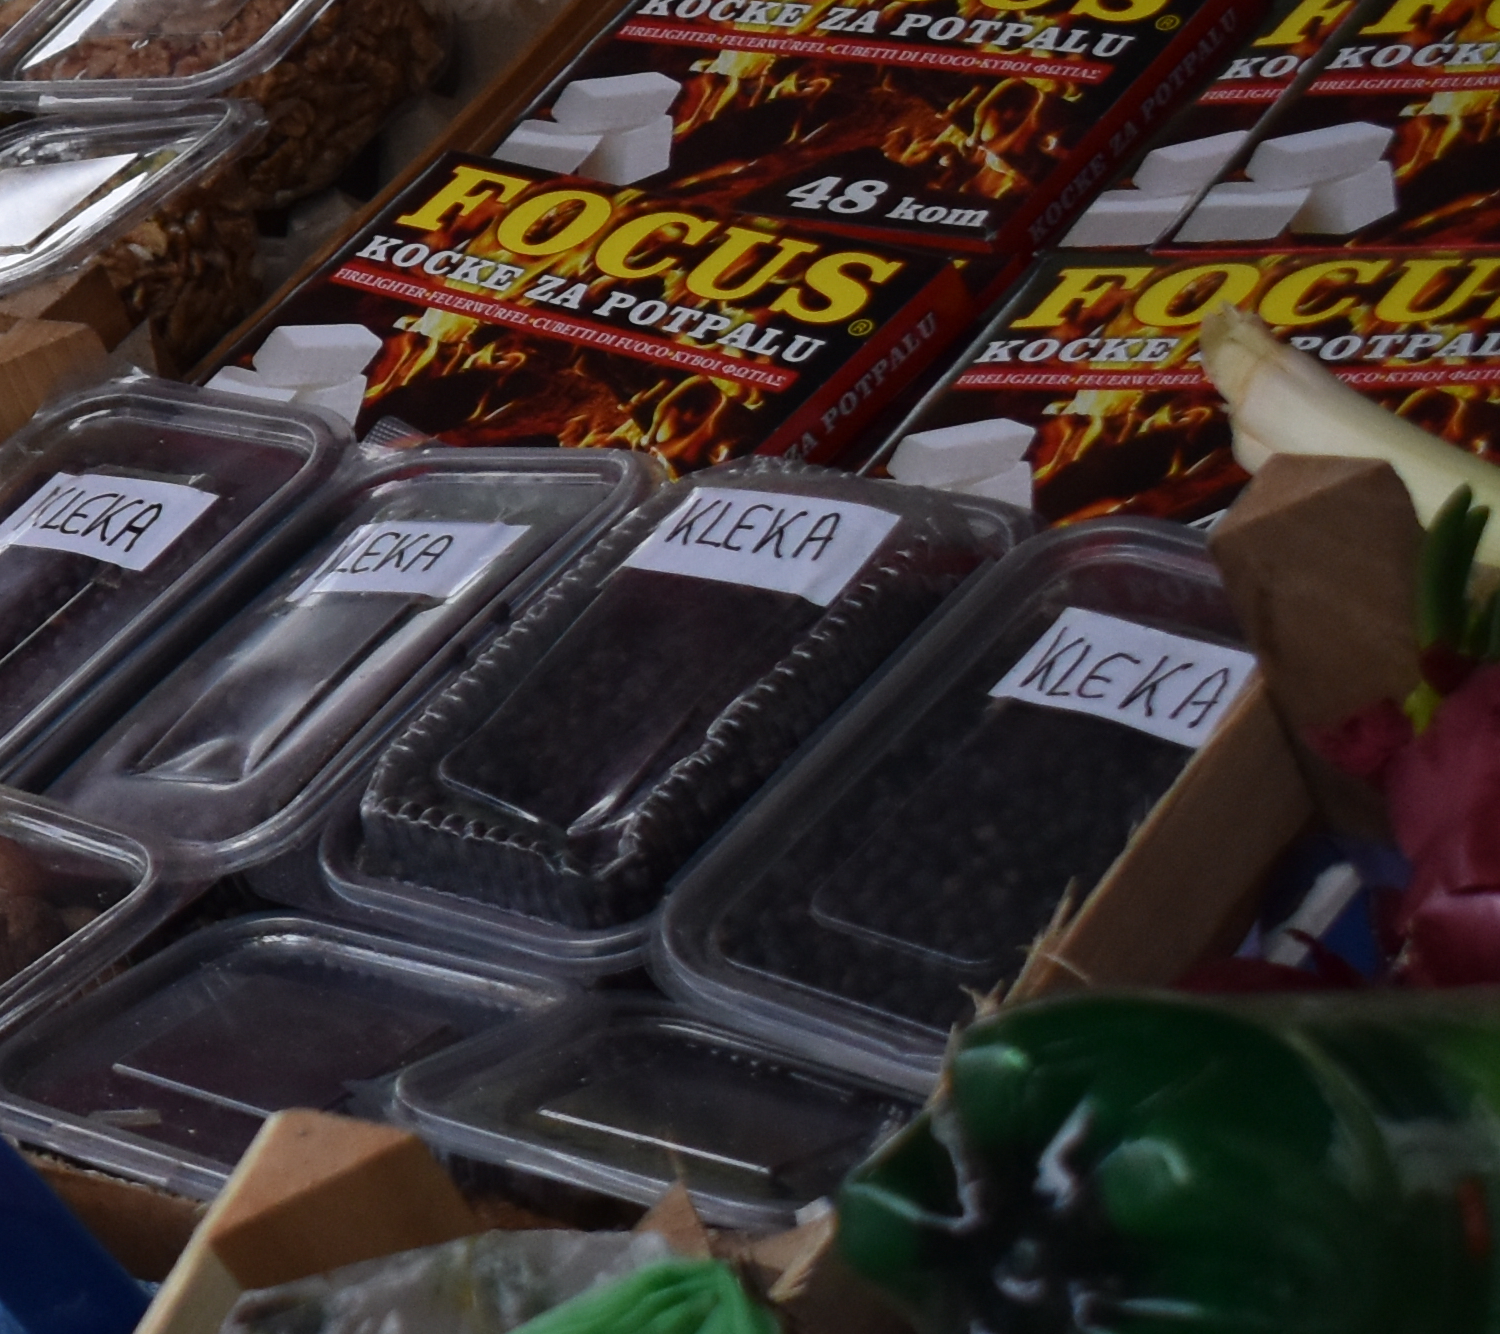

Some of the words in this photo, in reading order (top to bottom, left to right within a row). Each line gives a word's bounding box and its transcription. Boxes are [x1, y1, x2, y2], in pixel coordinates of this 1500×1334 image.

[819, 6, 879, 35] ZA
[888, 11, 1137, 58] POTPALU
[1027, 153, 1107, 244] KOCKE
[1109, 120, 1140, 158] ZA
[1140, 9, 1238, 121] POTPALU
[786, 175, 889, 215] 48
[885, 196, 989, 228] kom
[396, 165, 905, 323] FOCUS
[355, 235, 524, 292] KOCKE
[530, 272, 587, 309] ZA
[593, 290, 827, 364] POTPALU
[1010, 258, 1500, 329] FOCU
[820, 311, 937, 434] POTPALU
[972, 335, 1181, 364] KOCKE
[30, 485, 164, 553] KLEKA
[664, 495, 842, 562] KLEKA
[1020, 626, 1231, 729] KLEKA
